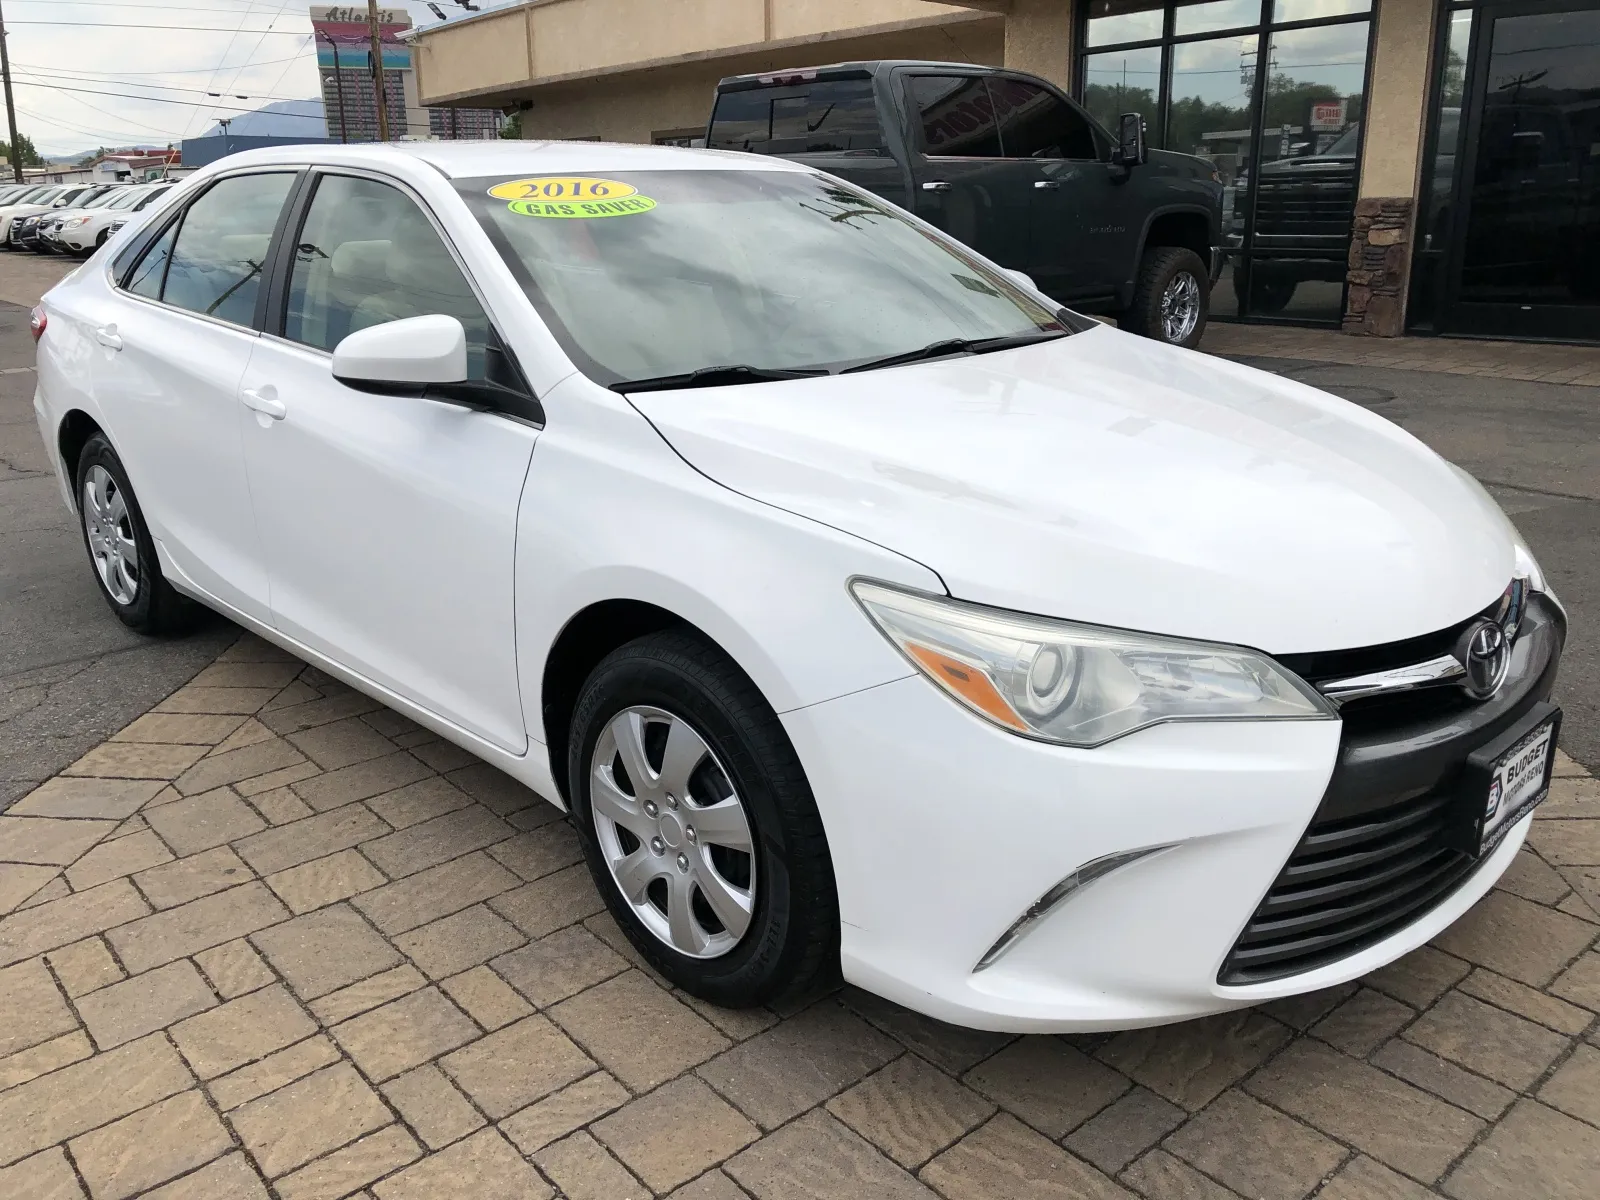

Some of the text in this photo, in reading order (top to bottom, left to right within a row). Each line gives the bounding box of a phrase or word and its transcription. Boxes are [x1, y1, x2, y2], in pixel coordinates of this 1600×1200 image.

[325, 6, 393, 23] Atlanis
[519, 181, 610, 199] 2016
[525, 199, 651, 215] GAS SAVER
[1506, 738, 1549, 785] BUDGET
